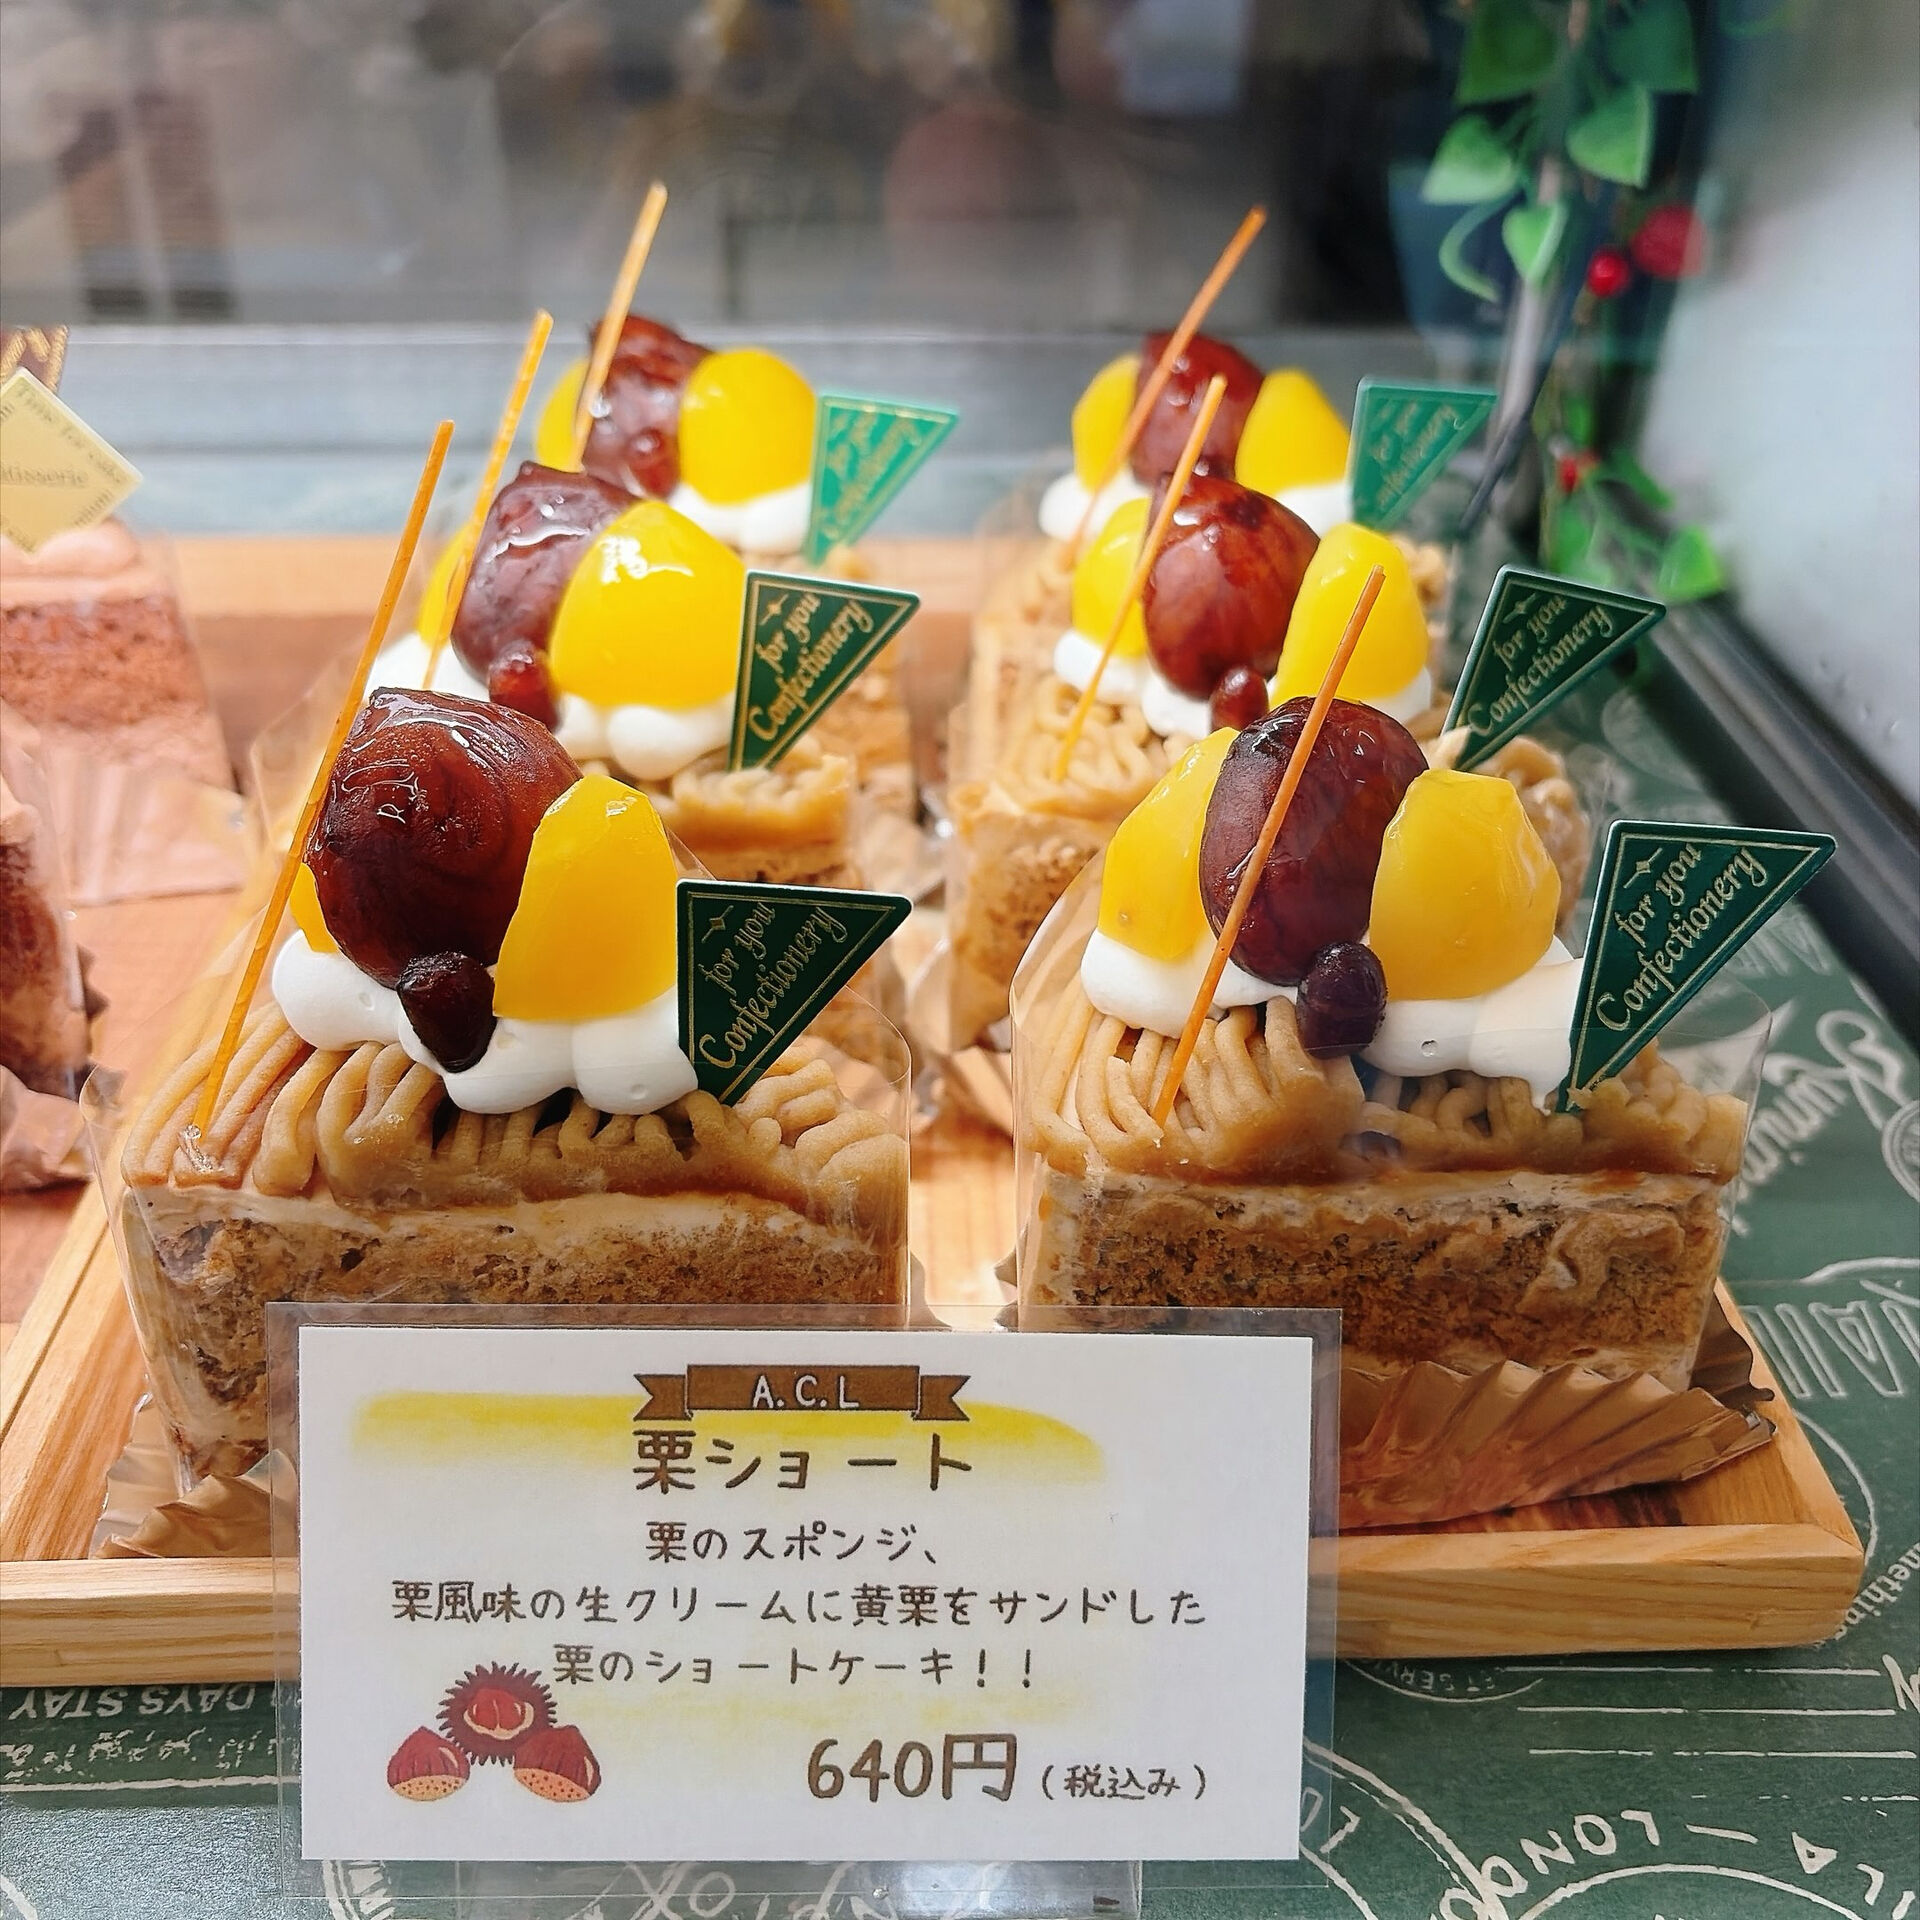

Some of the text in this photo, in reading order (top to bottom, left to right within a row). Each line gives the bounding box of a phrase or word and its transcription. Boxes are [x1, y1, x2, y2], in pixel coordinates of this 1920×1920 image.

[749, 600, 874, 741] Confectionery
[755, 593, 821, 674] for you
[1467, 606, 1613, 736] Confectionery
[1493, 595, 1566, 671] for you
[1614, 842, 1702, 949] for you
[698, 902, 776, 997] for you
[1595, 847, 1769, 1042] Confectionery
[699, 906, 848, 1070] Confectionery
[752, 1374, 860, 1409] A.C.L
[632, 1429, 973, 1494] 栗ショート
[645, 1520, 937, 1564] 栗のスポンジ、
[391, 1579, 1207, 1627] 栗風味の生クリームに黄栗をサンドした
[7, 1685, 129, 1721] STAY
[552, 1643, 1032, 1688] 栗のショートケーキ！！
[807, 1733, 1018, 1803] 640円
